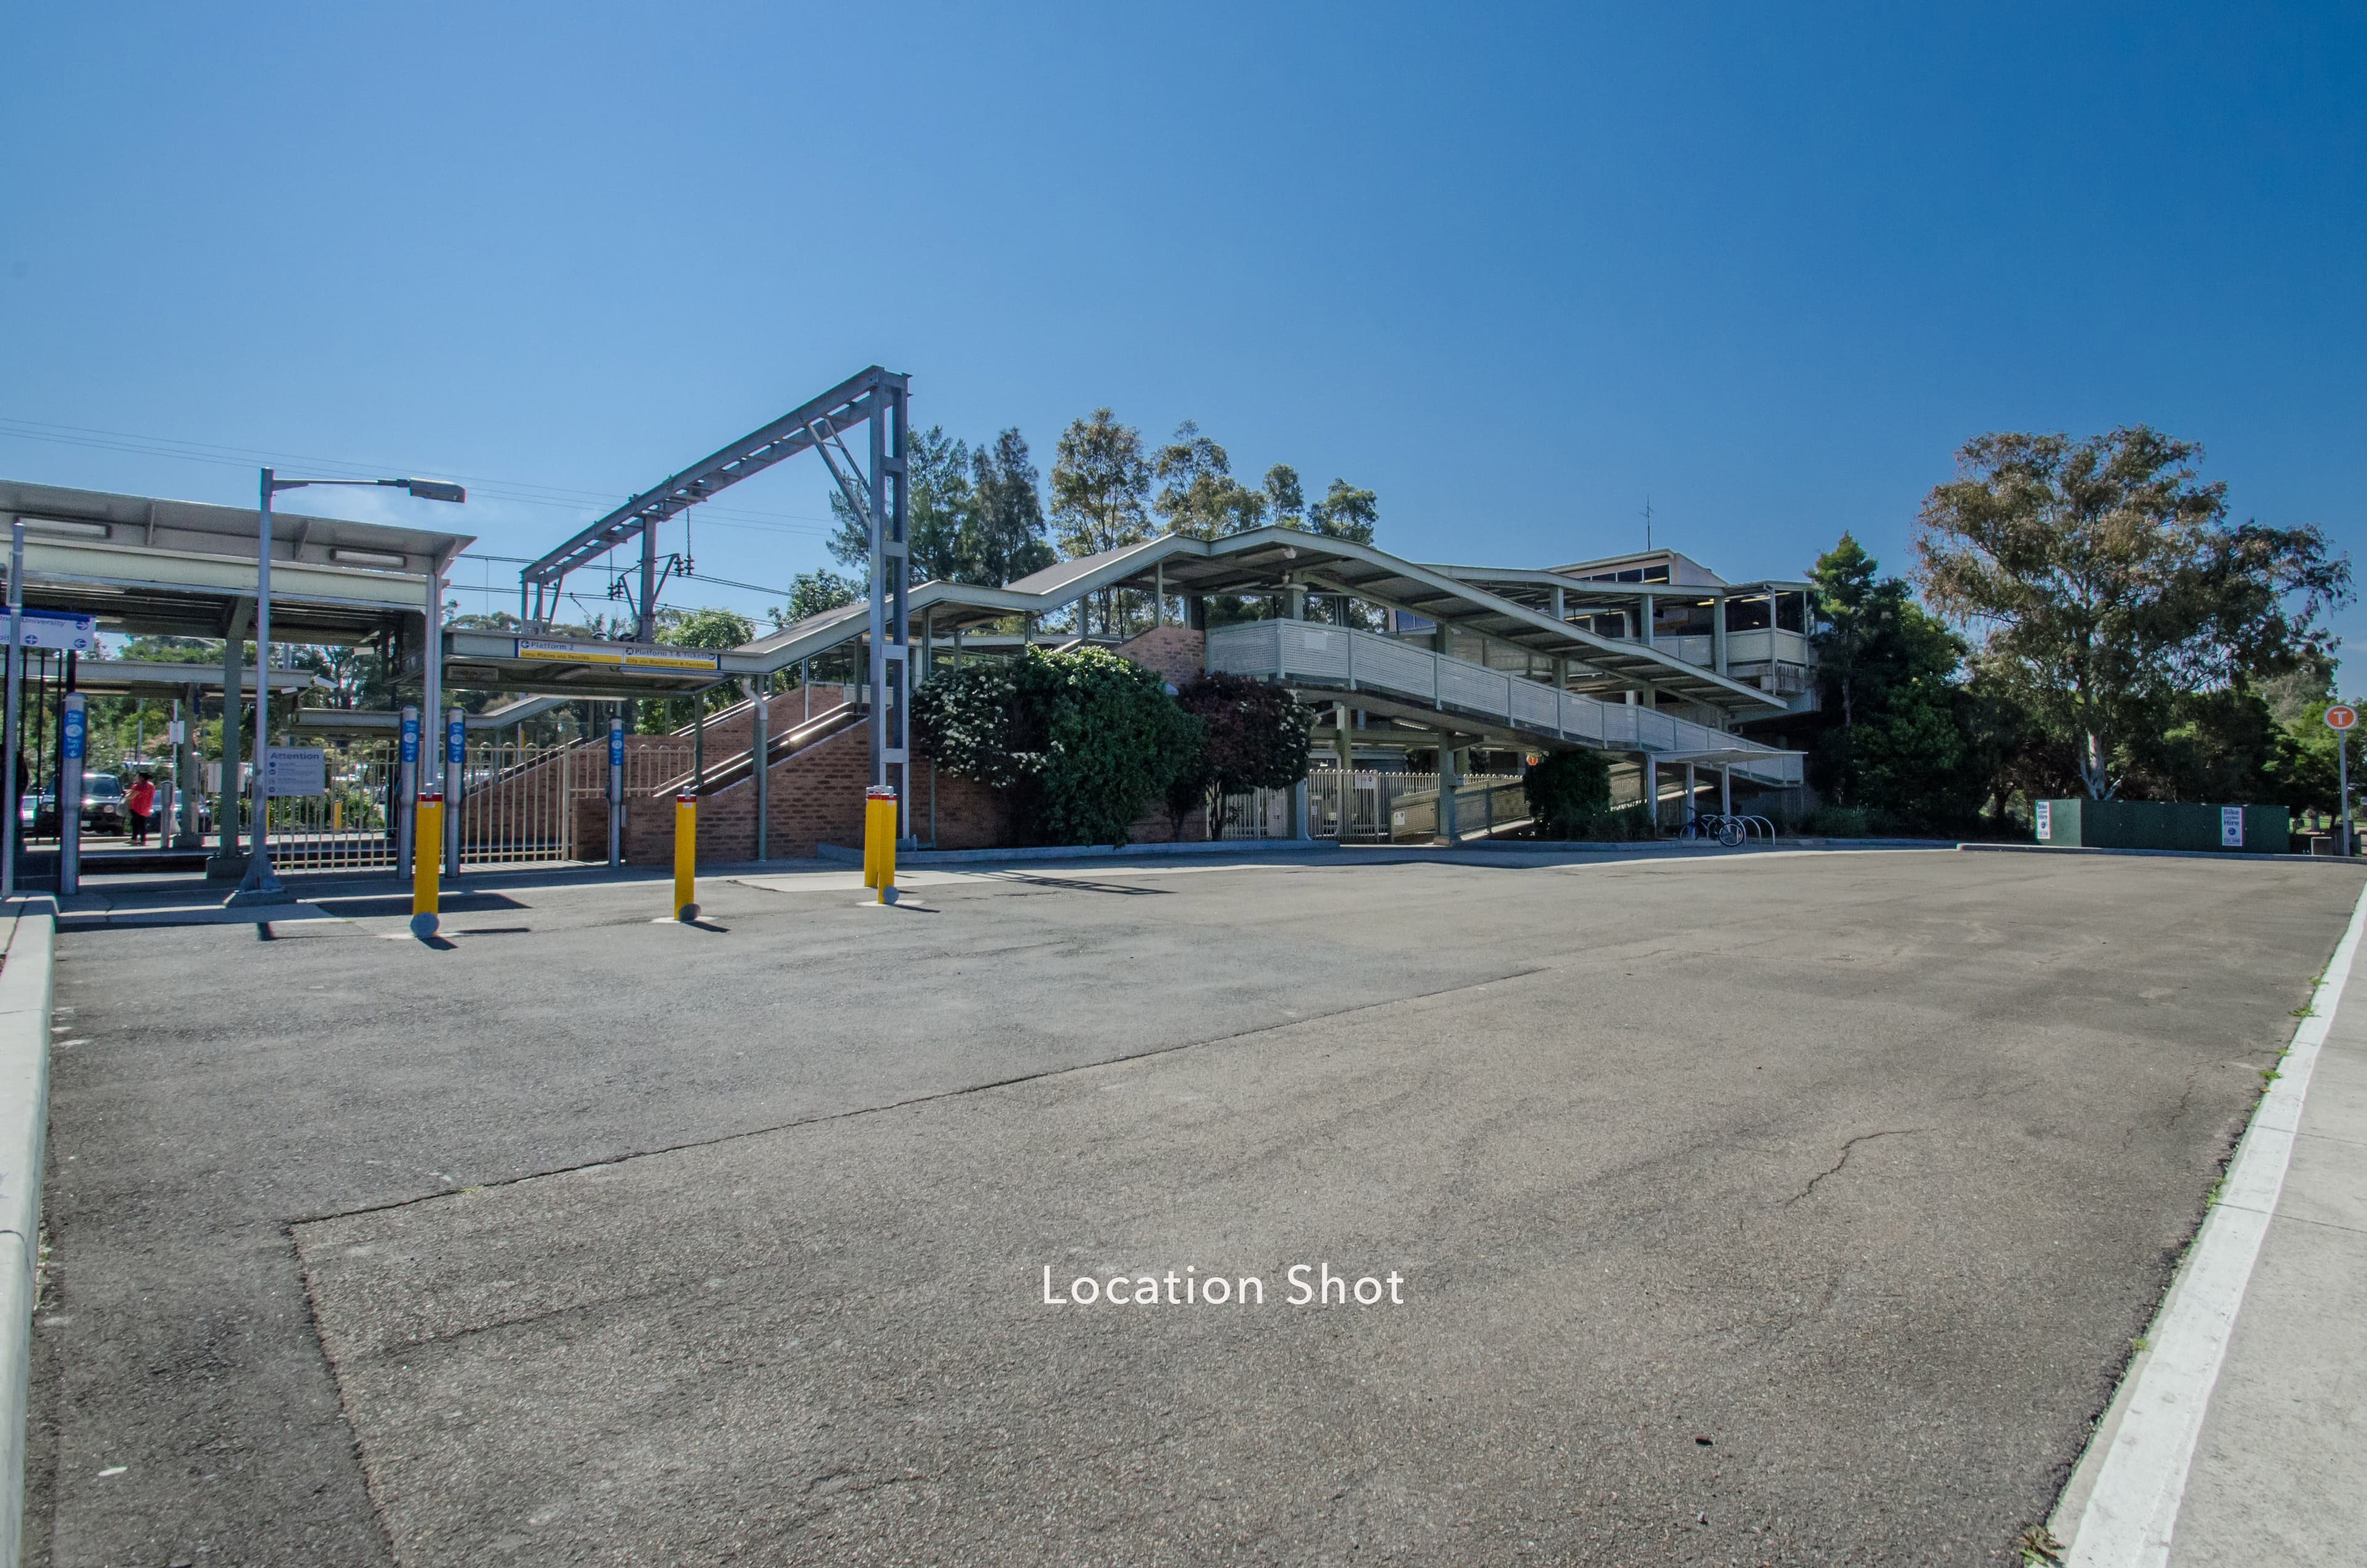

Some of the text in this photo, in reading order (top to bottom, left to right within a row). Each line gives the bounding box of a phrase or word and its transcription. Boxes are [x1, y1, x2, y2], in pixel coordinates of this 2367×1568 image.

[22, 617, 65, 627] University
[531, 641, 566, 650] Platform
[635, 648, 667, 656] Platform
[2333, 711, 2347, 725] T
